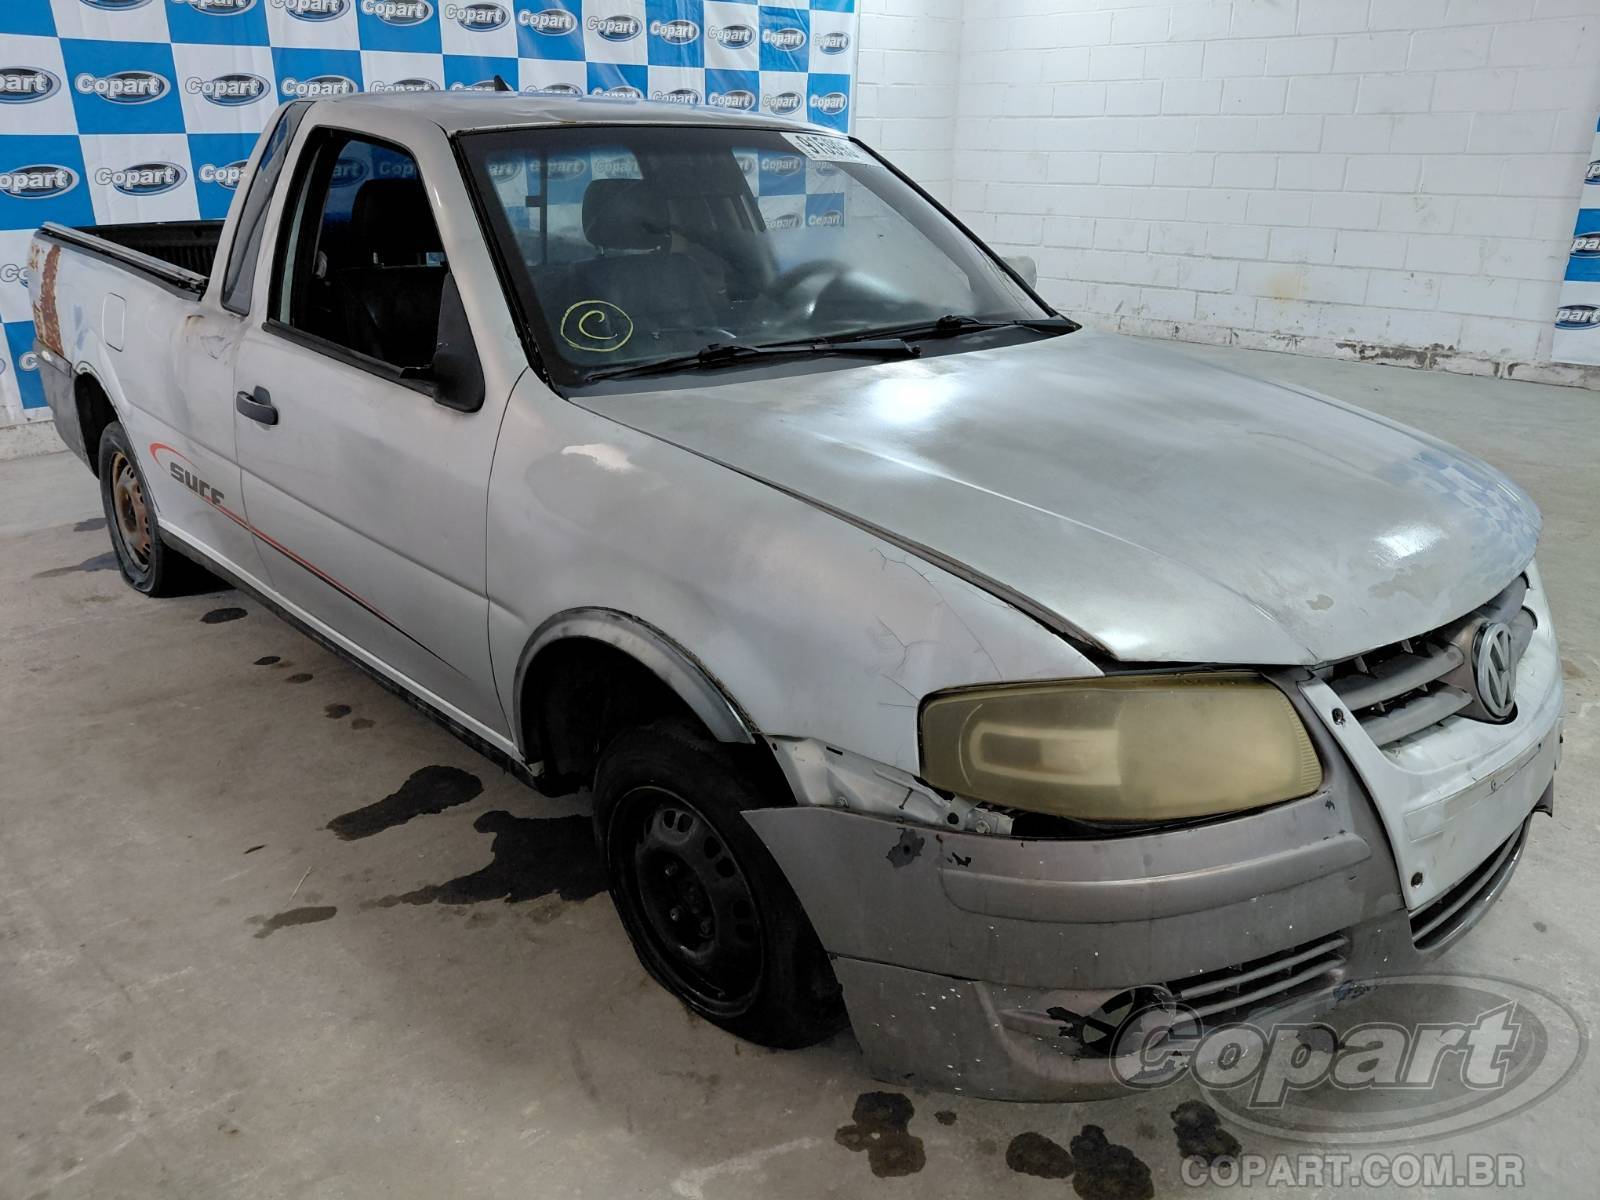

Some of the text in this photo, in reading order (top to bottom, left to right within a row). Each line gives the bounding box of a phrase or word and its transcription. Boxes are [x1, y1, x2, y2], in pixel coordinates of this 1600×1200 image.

[361, 0, 424, 19] Copart
[446, 4, 502, 25] Copart
[518, 11, 572, 28] Copart
[587, 16, 636, 34] Copart
[651, 21, 694, 38] Copart
[708, 25, 750, 43] Copart
[761, 29, 802, 45] Copart
[813, 33, 848, 49] Copart
[76, 73, 158, 97] Copart
[186, 77, 259, 97] Copart
[281, 79, 349, 97] Copart
[708, 93, 750, 108] Copart
[763, 95, 799, 109] Copart
[809, 94, 845, 109] Copart
[761, 158, 799, 172] Copart
[95, 167, 175, 188] Copart
